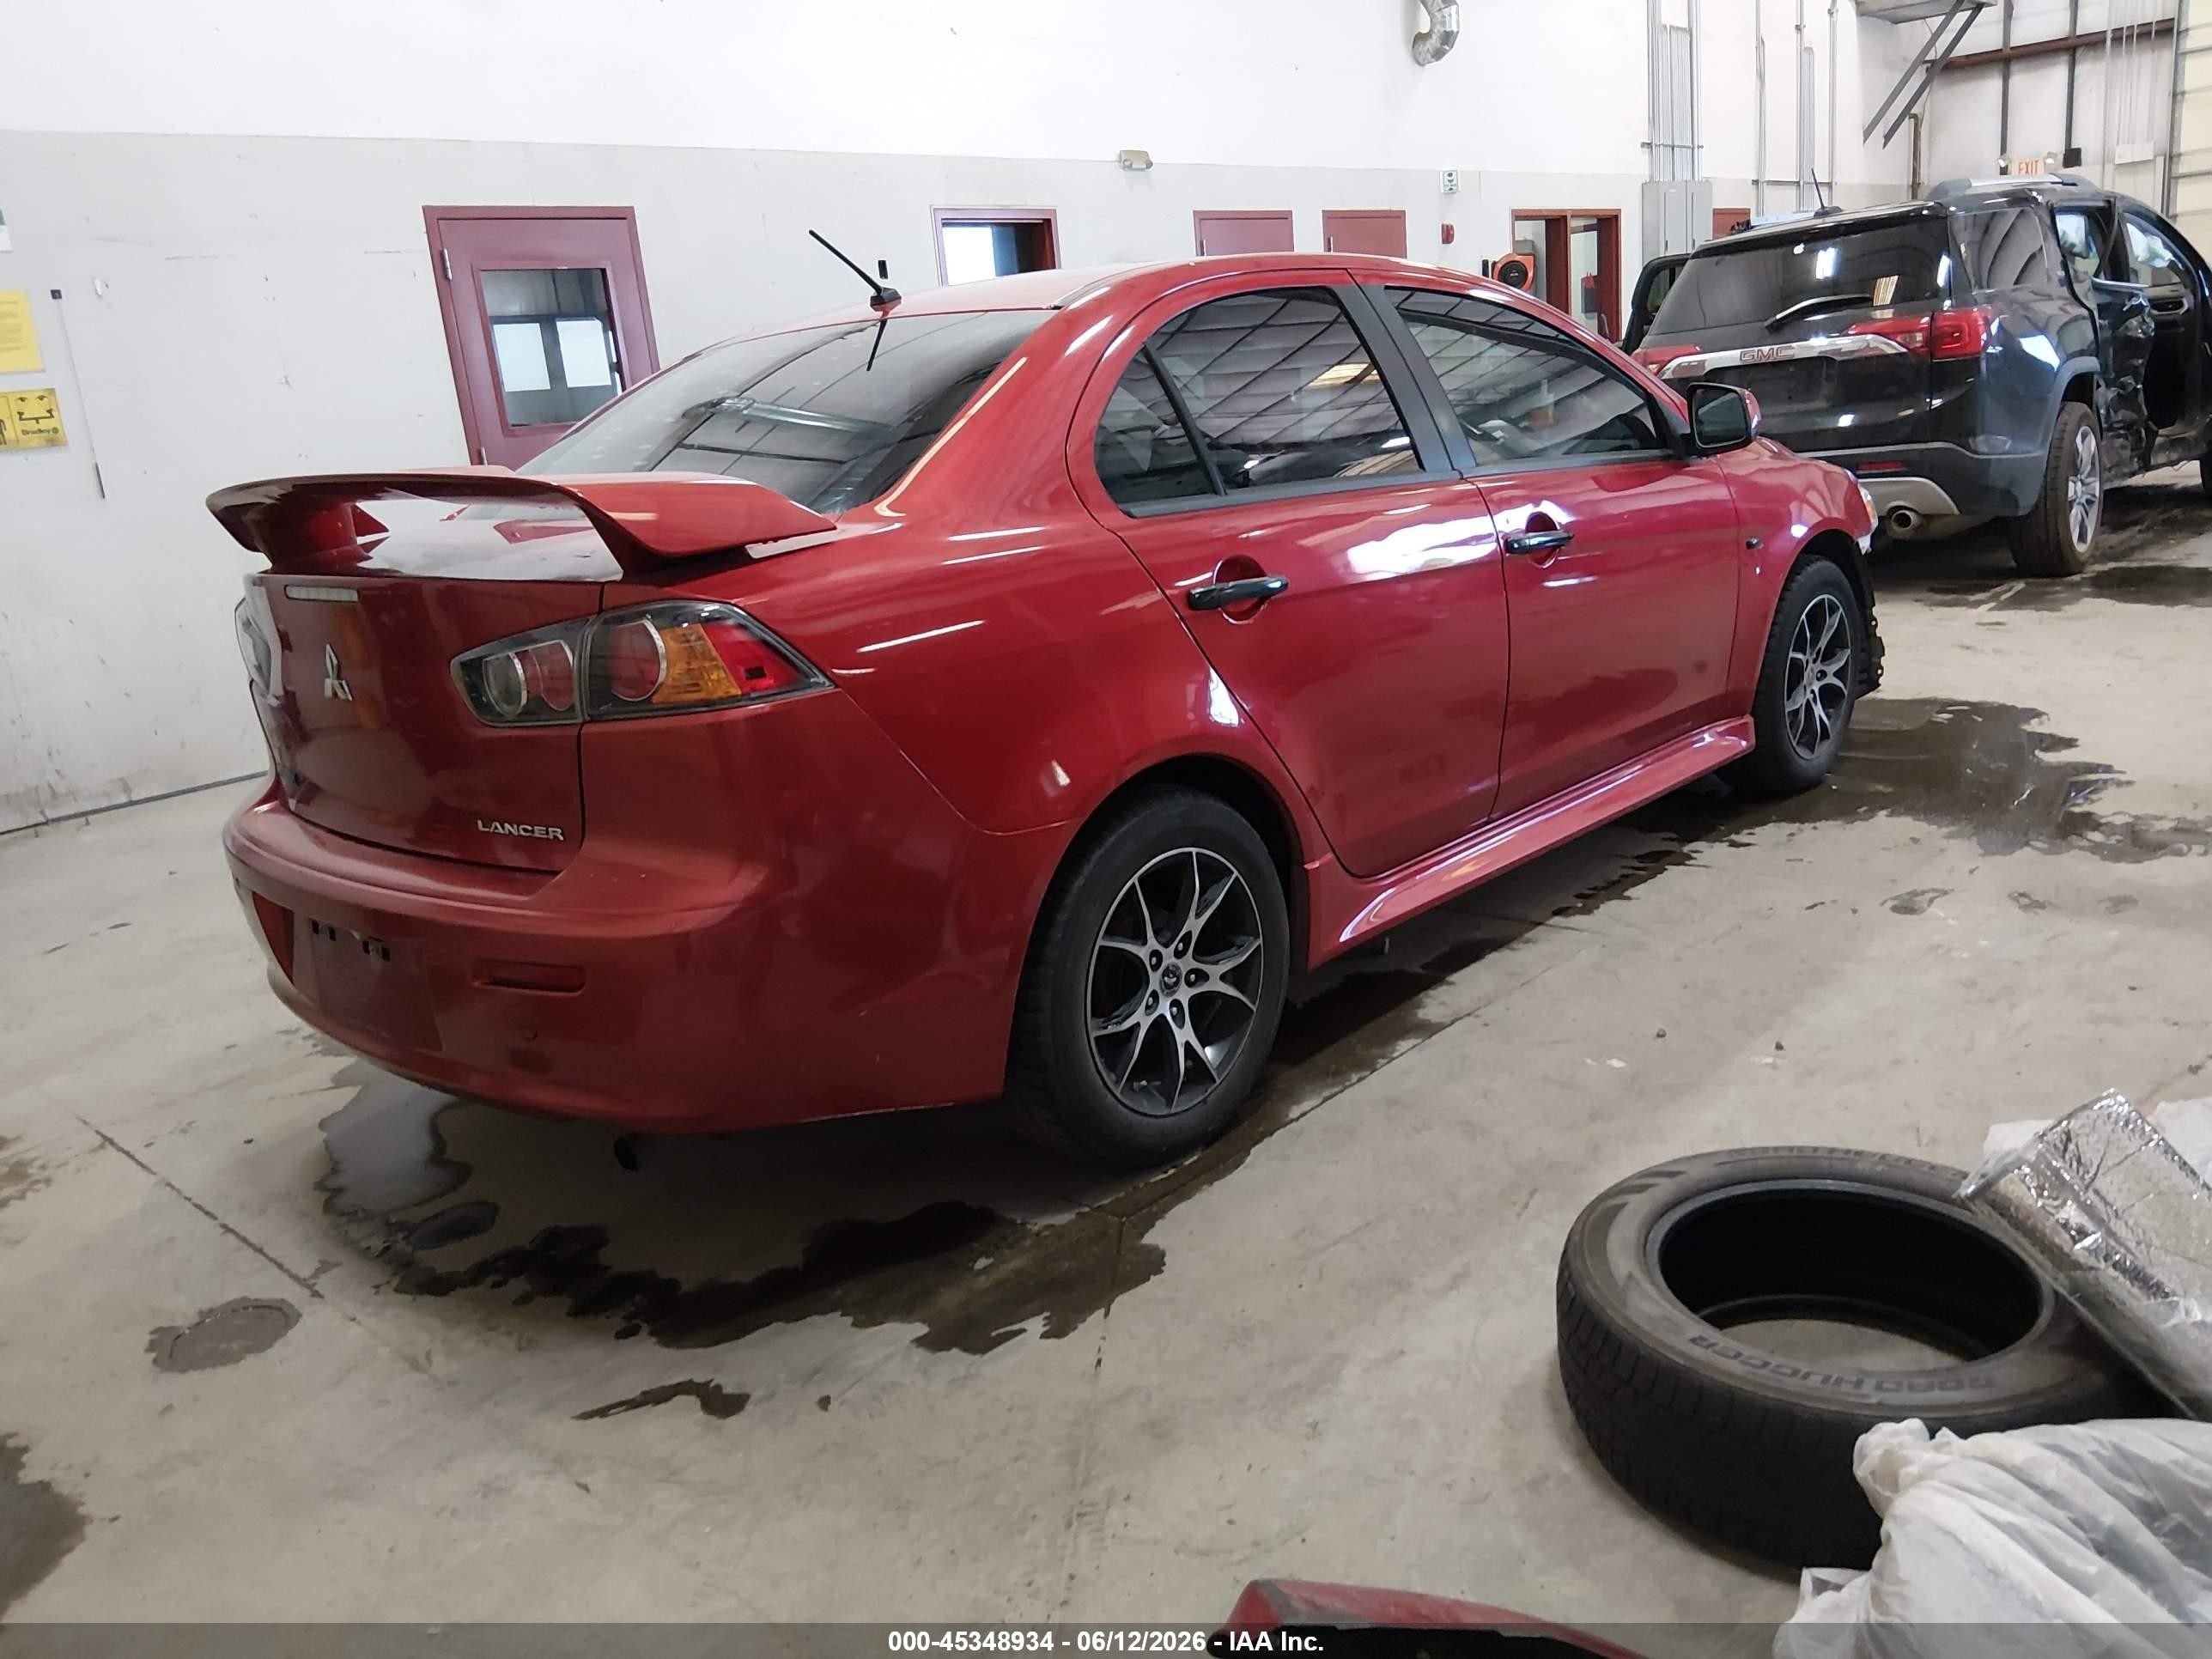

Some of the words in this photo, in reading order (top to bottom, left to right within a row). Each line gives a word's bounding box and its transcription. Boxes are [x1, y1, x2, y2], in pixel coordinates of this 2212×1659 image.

[2018, 160, 2039, 176] EXIT
[1740, 345, 1796, 364] GMC
[477, 819, 565, 842] LANCER
